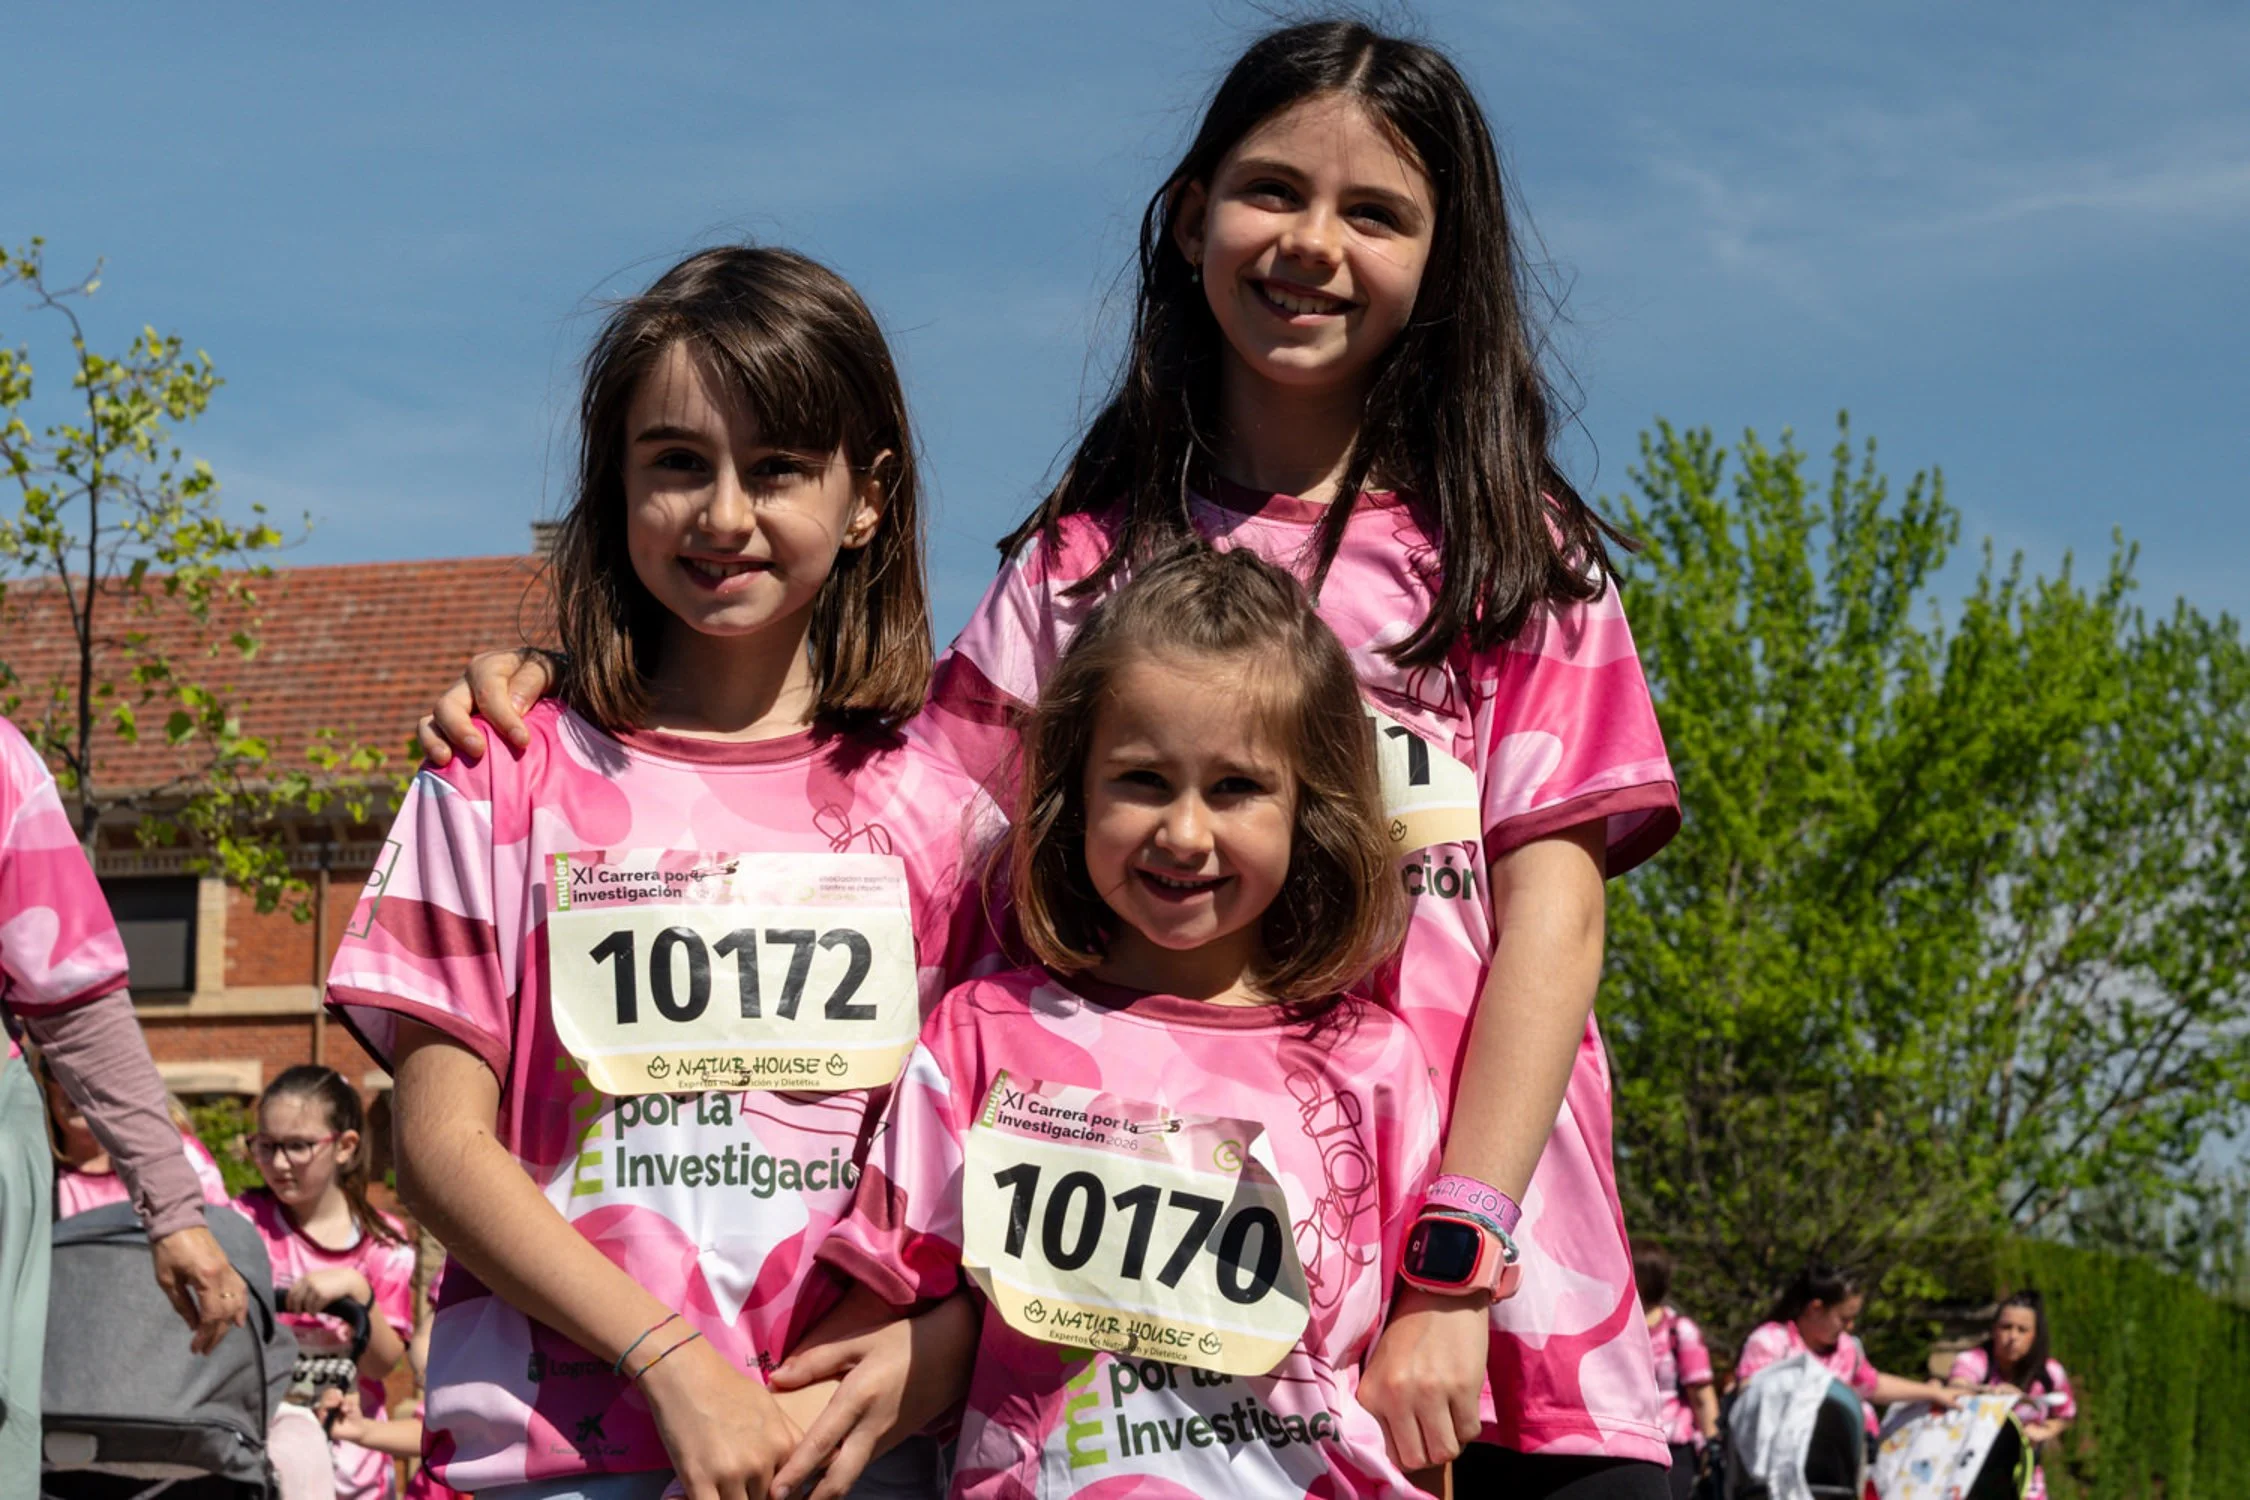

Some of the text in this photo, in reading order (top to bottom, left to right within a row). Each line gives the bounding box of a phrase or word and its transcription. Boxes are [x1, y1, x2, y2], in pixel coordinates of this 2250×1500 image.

[553, 858, 571, 907] mujer
[572, 866, 593, 886] XI
[598, 869, 661, 884] Carrera
[572, 886, 683, 903] investigación
[589, 926, 878, 1025] 10172
[676, 1056, 821, 1077] NATUR HOUSE
[614, 1091, 733, 1140] por la
[997, 1110, 1139, 1151] investigación 2026
[1002, 1087, 1139, 1135] XI Carrera por la
[1467, 1189, 1506, 1222] TOP
[993, 1162, 1283, 1304] 10170
[1050, 1307, 1195, 1348] NATUR HOUSE
[1108, 1359, 1178, 1408] por
